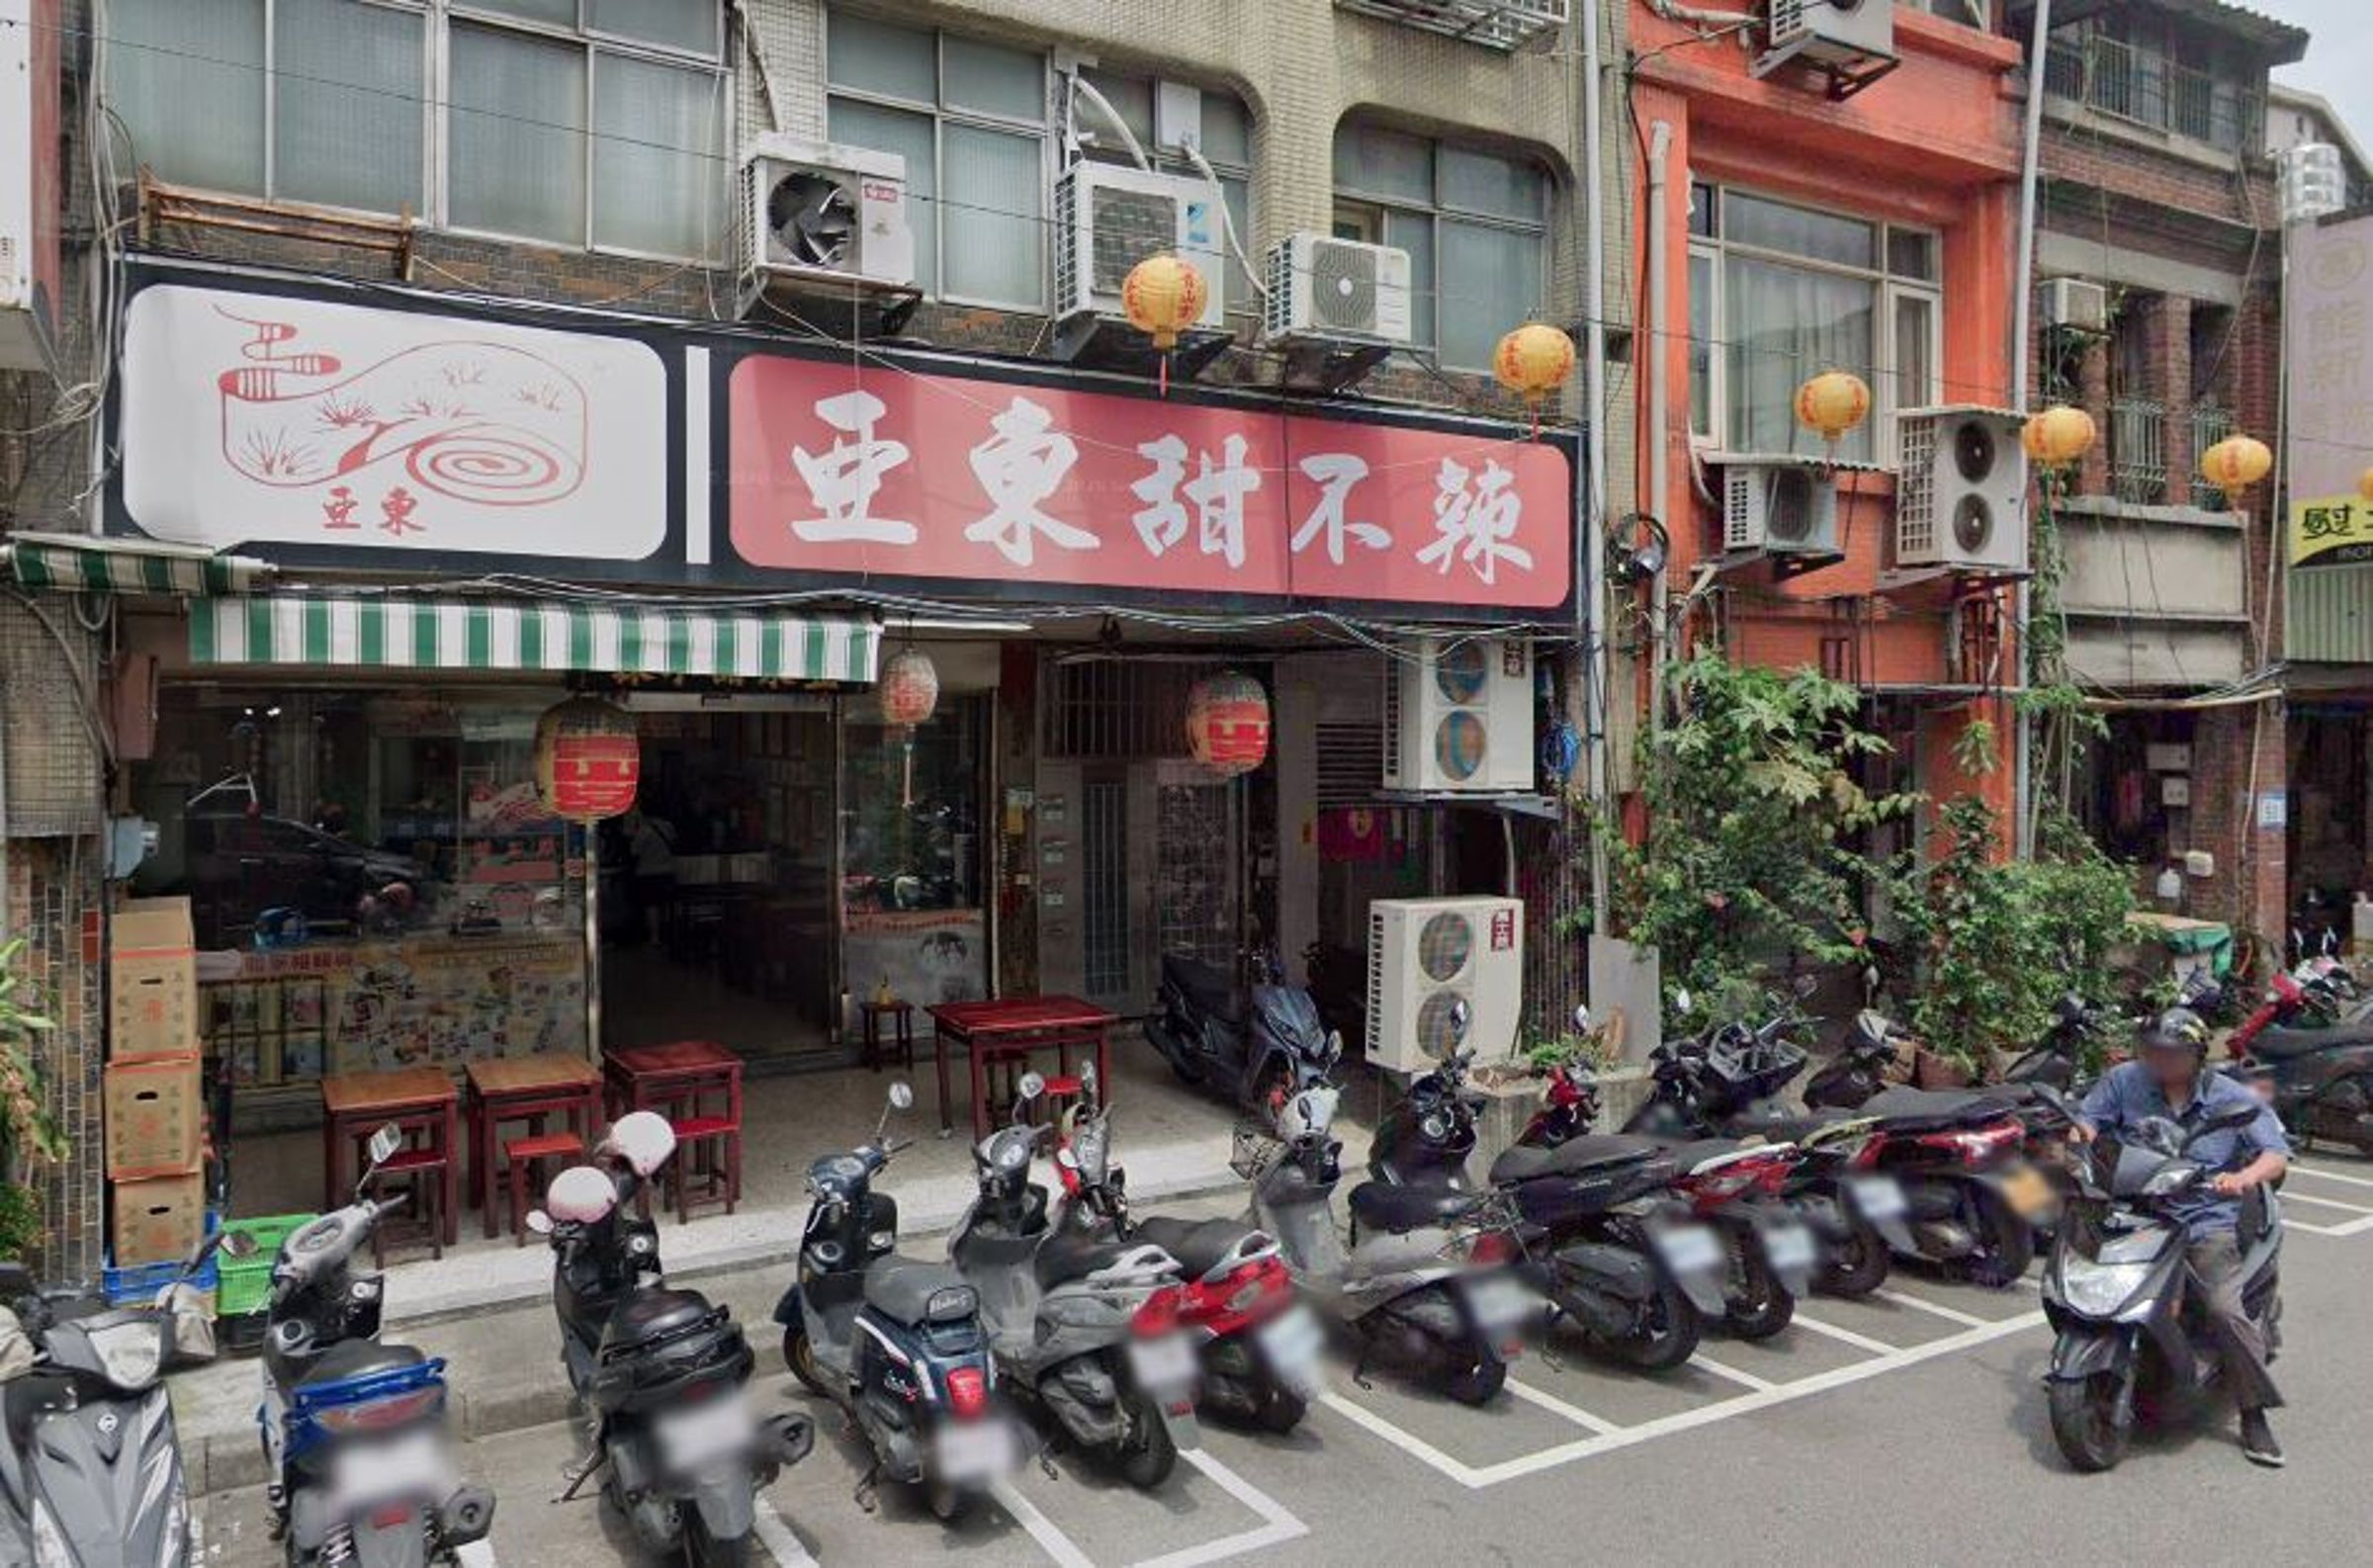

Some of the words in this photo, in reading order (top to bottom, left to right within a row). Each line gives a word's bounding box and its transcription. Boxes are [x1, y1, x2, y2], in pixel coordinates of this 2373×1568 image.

[791, 391, 1534, 584] 亞東甜不辣
